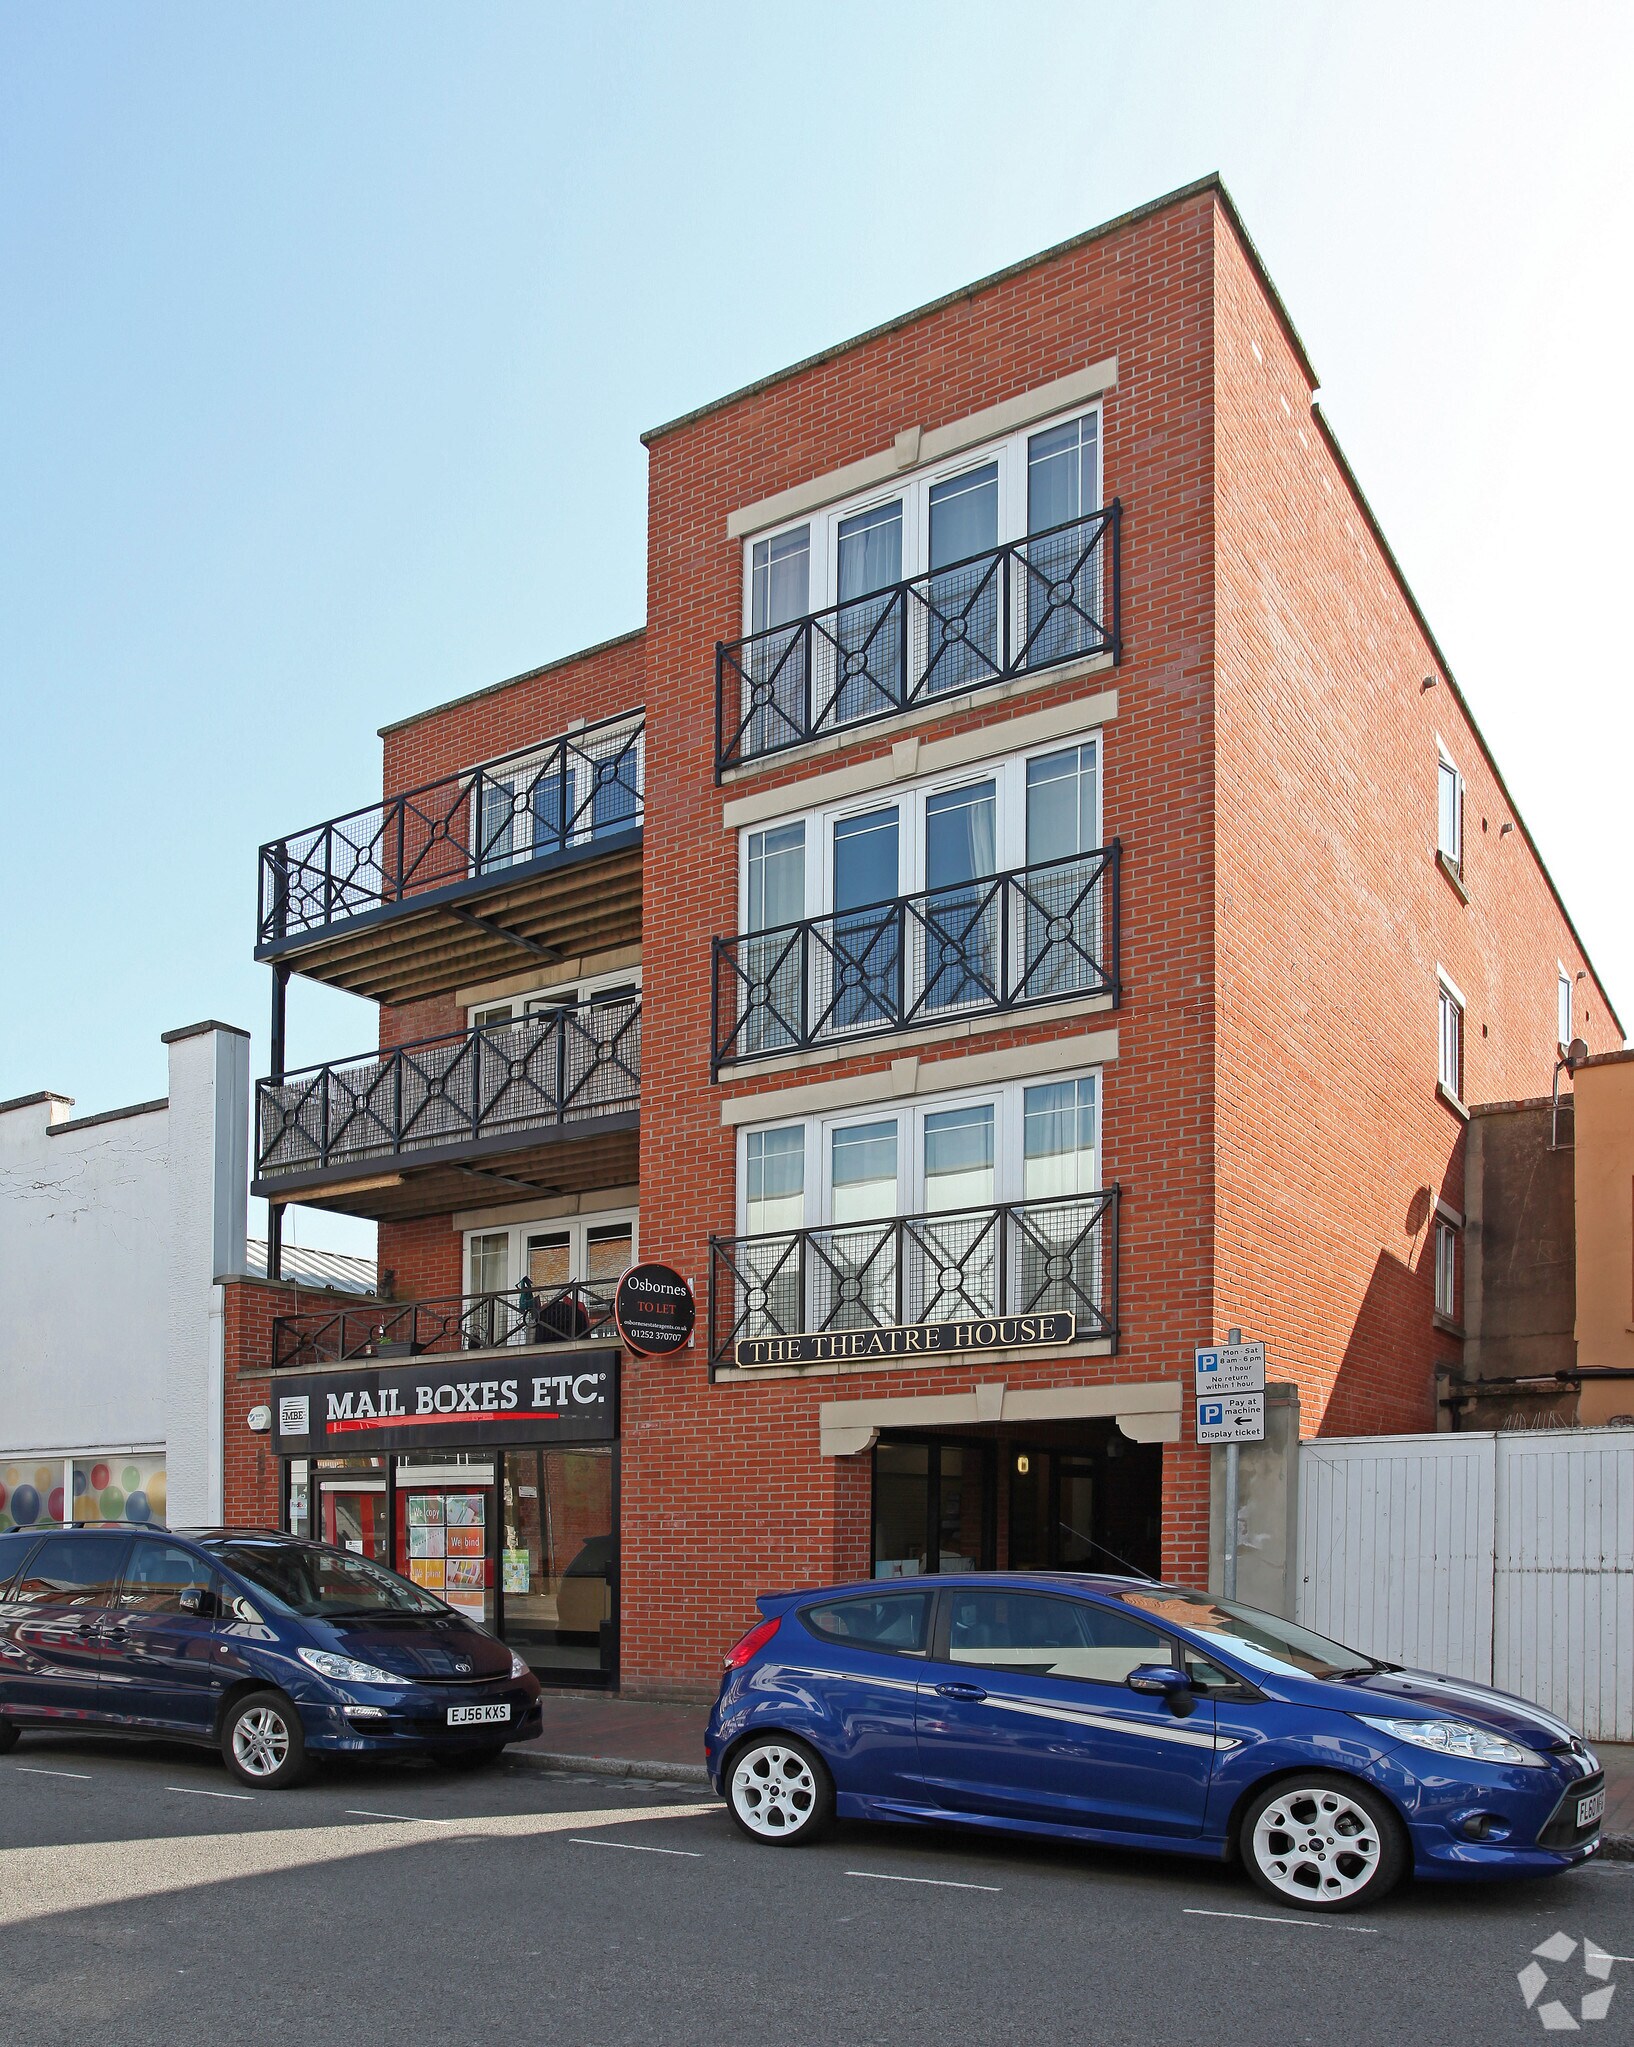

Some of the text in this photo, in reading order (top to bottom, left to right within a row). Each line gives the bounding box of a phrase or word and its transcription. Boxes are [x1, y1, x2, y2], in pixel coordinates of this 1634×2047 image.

[628, 1276, 686, 1296] Osbornes
[638, 1301, 676, 1314] TO LET
[624, 1320, 688, 1332] osbornesestateagents.co.uk
[631, 1329, 681, 1342] 01252 370707
[749, 1318, 1056, 1363] THE THEATRE HOUSE
[1203, 1356, 1214, 1371] P
[326, 1388, 406, 1420] MAIL
[415, 1379, 518, 1415] BOXES
[1229, 1399, 1245, 1407] Pay
[1205, 1406, 1219, 1423] P
[413, 1508, 440, 1519] We copy
[450, 1537, 480, 1547] We bind
[452, 1706, 506, 1722] EJ56 KXS
